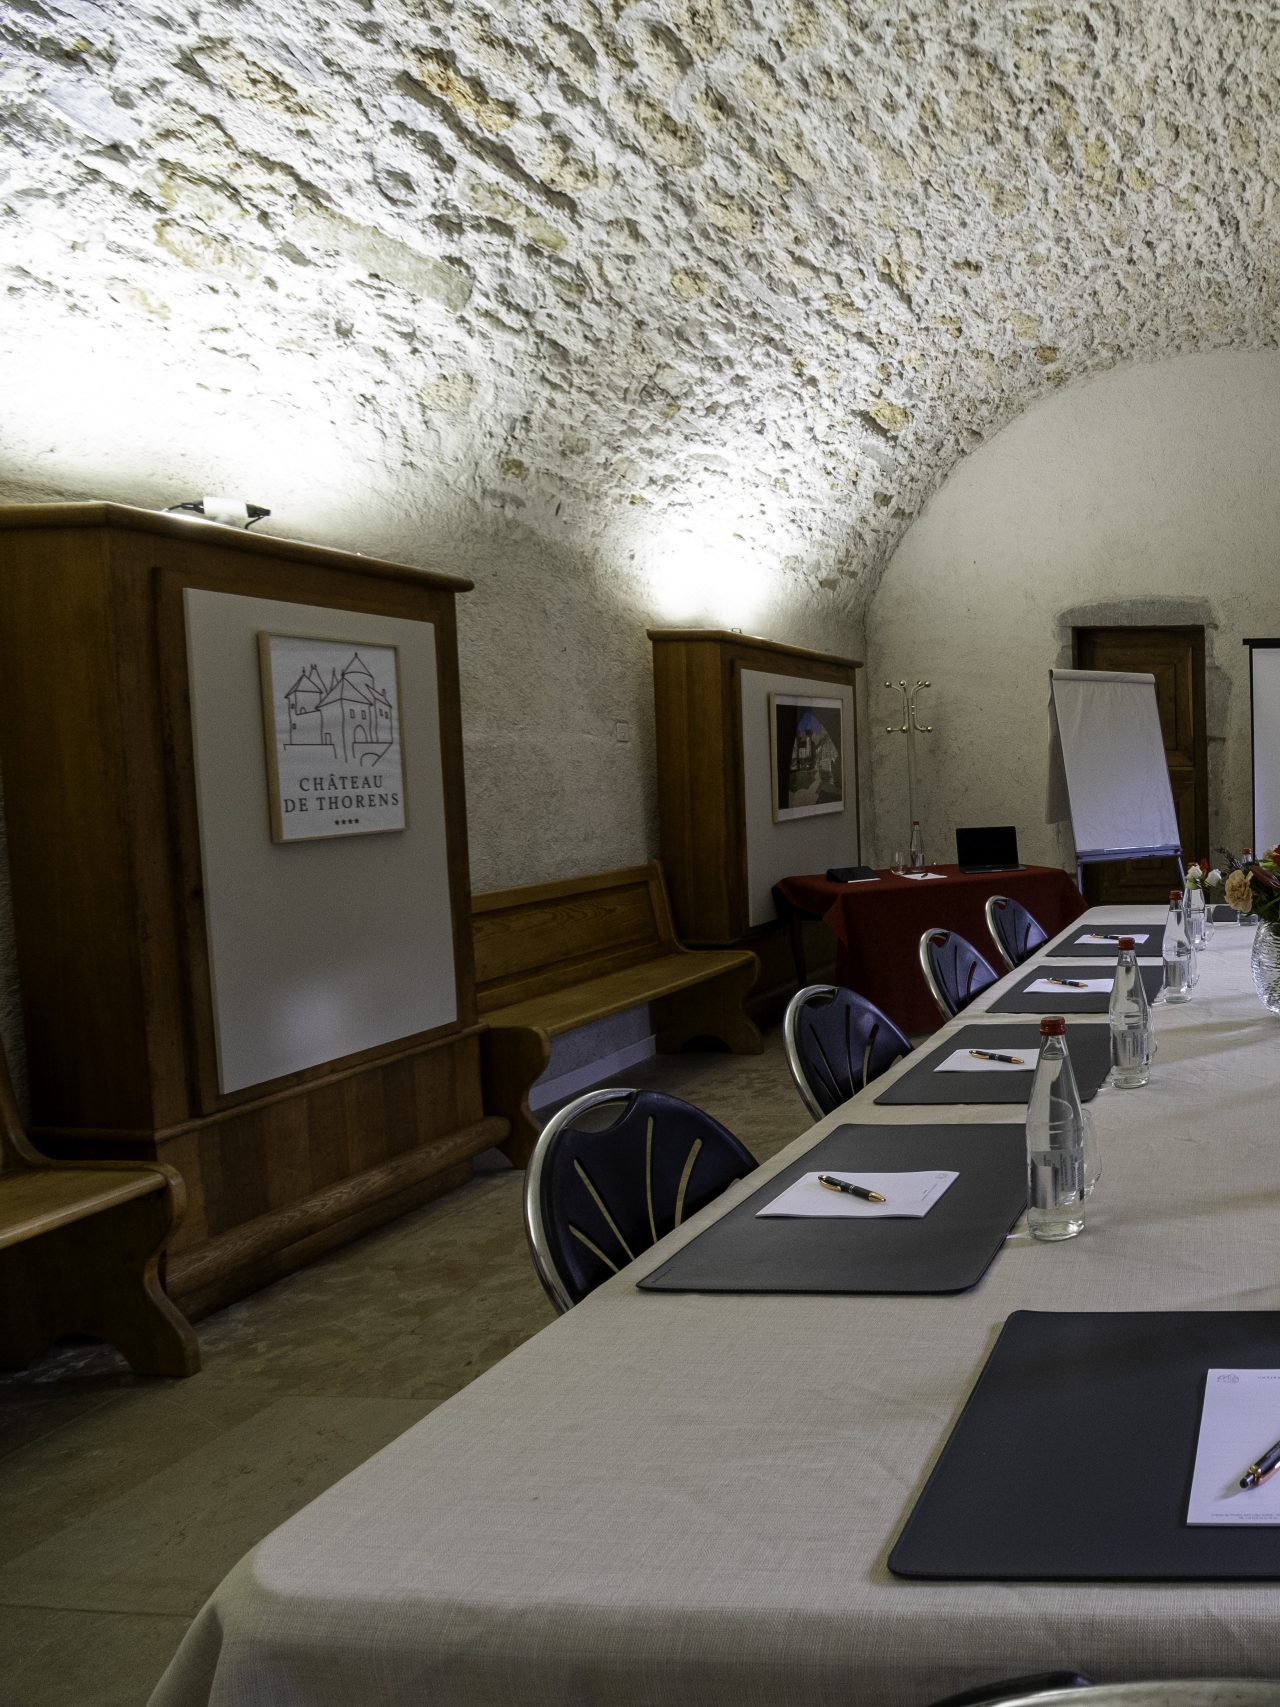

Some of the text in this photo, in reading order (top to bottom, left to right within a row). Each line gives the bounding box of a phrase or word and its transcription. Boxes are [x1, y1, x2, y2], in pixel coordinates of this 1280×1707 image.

[299, 773, 383, 792] CHÂTEAU
[284, 792, 400, 813] DE THORENS
